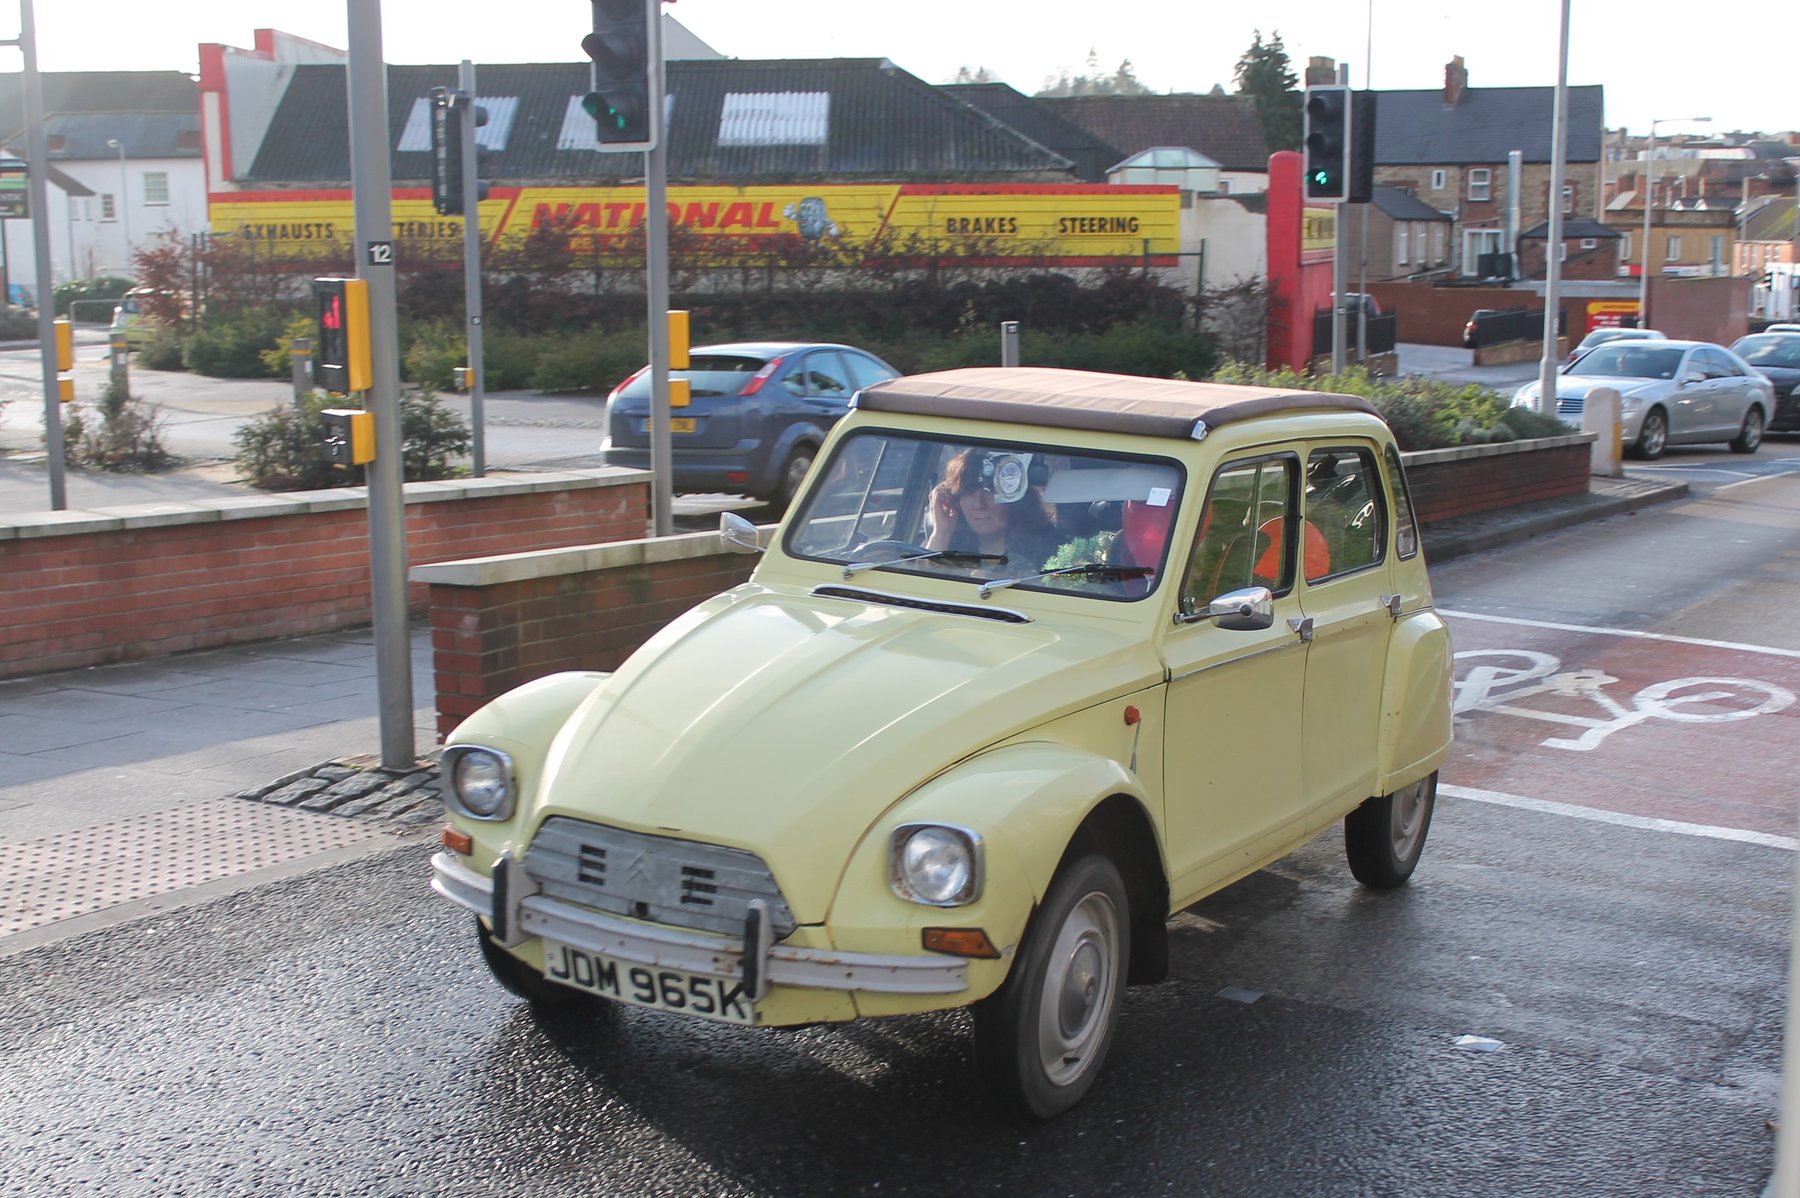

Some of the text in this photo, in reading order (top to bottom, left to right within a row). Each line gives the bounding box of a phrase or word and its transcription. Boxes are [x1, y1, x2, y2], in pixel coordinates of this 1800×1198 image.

[244, 222, 334, 240] EXHAUSTS
[391, 221, 458, 239] TERIES
[946, 217, 1017, 234] BRAKES
[1059, 217, 1139, 233] STEERING
[370, 244, 391, 262] 12
[551, 946, 746, 1019] JDM 965K
